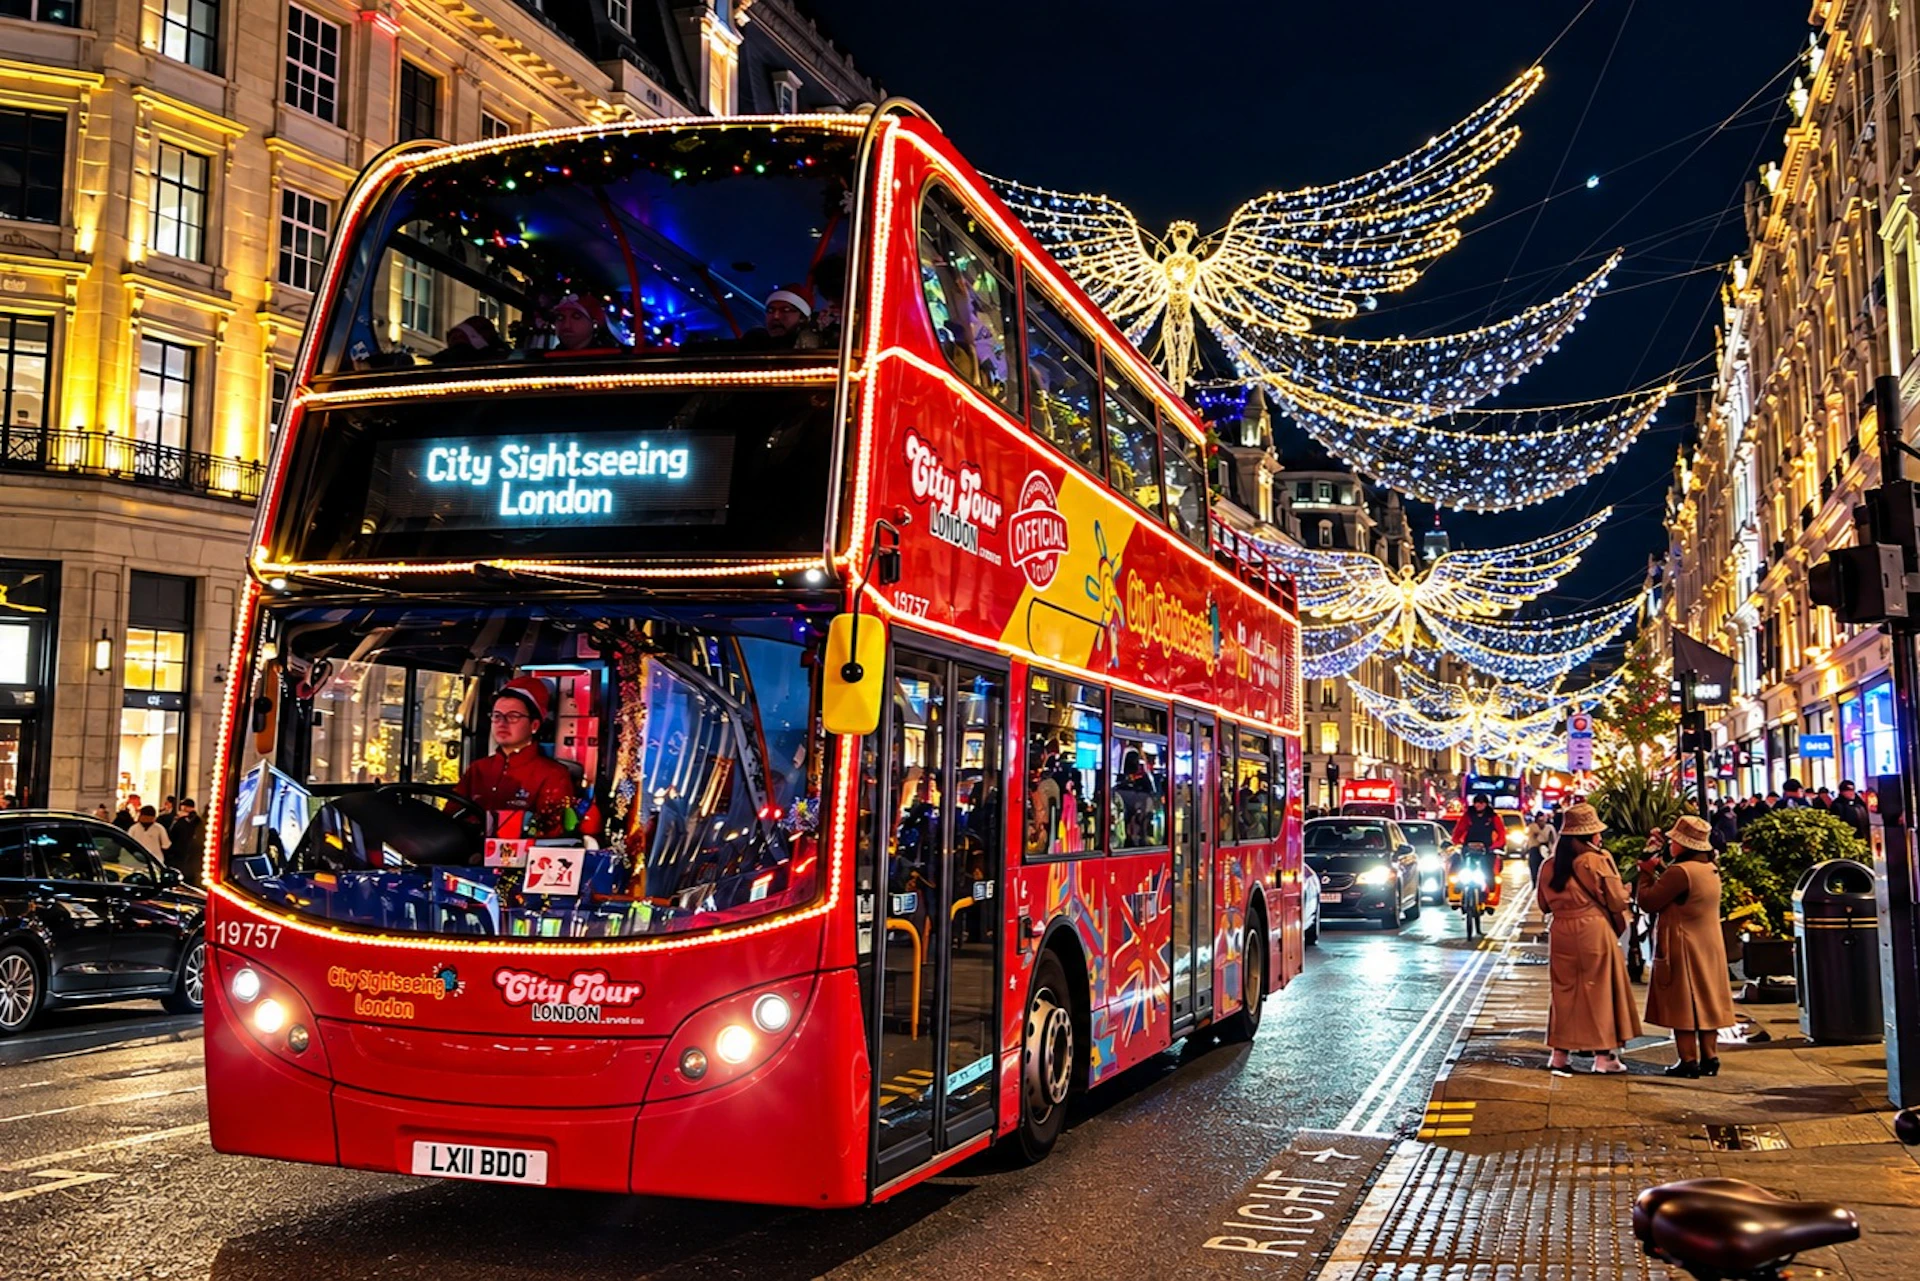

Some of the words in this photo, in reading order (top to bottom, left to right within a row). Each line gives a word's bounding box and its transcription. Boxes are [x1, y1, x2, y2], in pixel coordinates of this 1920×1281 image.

[427, 446, 491, 485] City
[499, 441, 688, 481] Sightseeing
[500, 479, 612, 516] London
[906, 435, 955, 514] City
[957, 468, 1001, 529] Tour
[930, 502, 979, 555] LONDON
[1016, 518, 1066, 555] OFFICIAL
[894, 591, 930, 618] 19757
[1127, 569, 1153, 648] City
[1153, 582, 1214, 677] Sightseeing
[217, 921, 281, 949] 19757
[328, 966, 357, 992] City
[358, 969, 446, 1000] Sightseeing
[497, 970, 563, 1005] City
[568, 972, 640, 1005] Tour
[355, 993, 414, 1019] London
[532, 1003, 600, 1024] LONDON
[430, 1145, 474, 1175] LX11
[480, 1149, 526, 1178] BDO
[1202, 1169, 1347, 1258] RIGHT
